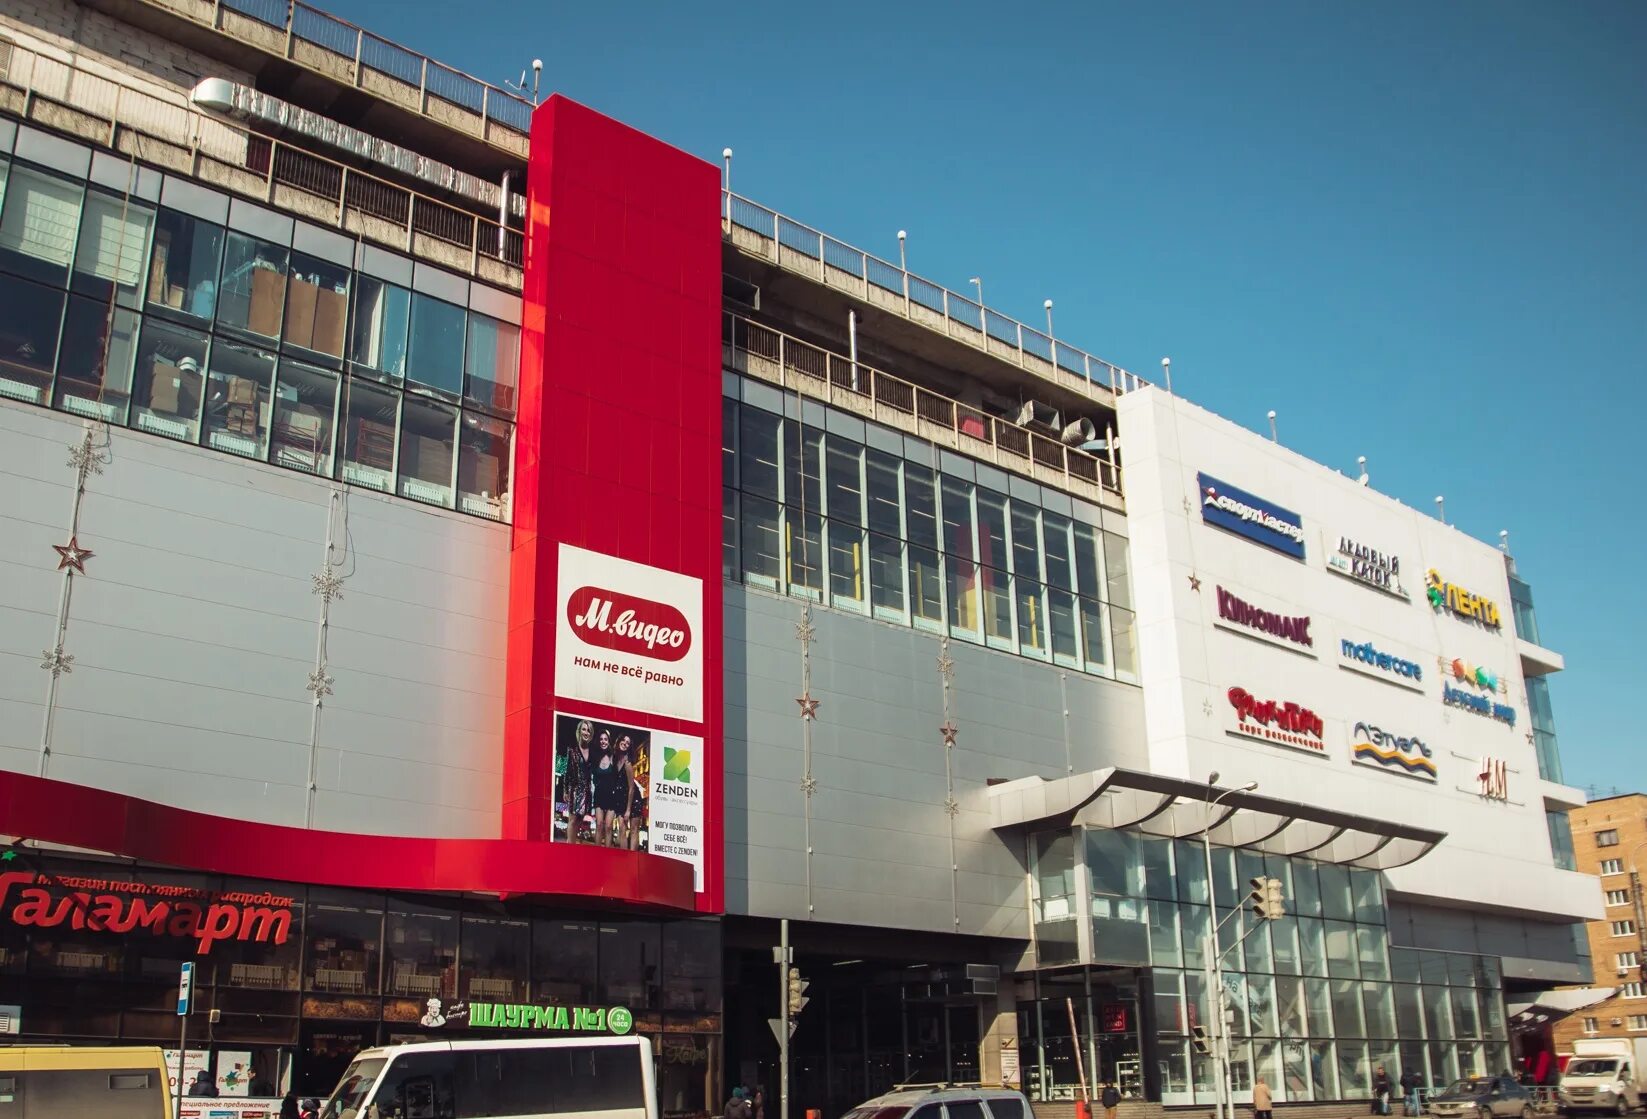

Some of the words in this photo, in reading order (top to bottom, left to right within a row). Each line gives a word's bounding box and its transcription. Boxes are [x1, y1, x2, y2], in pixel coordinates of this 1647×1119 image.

[1351, 558, 1391, 589] КАТОК
[1442, 582, 1502, 629] ЛЕНТА
[1341, 638, 1423, 682] mothercare
[573, 656, 601, 670] нам
[603, 662, 619, 674] не
[621, 666, 643, 678] всё
[644, 670, 684, 687] равно
[655, 783, 698, 798] ZENDEN
[655, 820, 669, 830] МОГУ
[669, 822, 698, 833] ПОЗВОЛИТЬ
[664, 833, 676, 842] СЕБЕ
[654, 844, 674, 854] ВМЕСТЕ
[0, 871, 292, 955] Галамарт
[469, 1003, 569, 1030] ШАУРМА
[573, 1007, 607, 1031] №1
[172, 1052, 203, 1060] Гаамарт
[223, 1101, 270, 1109] предложение
